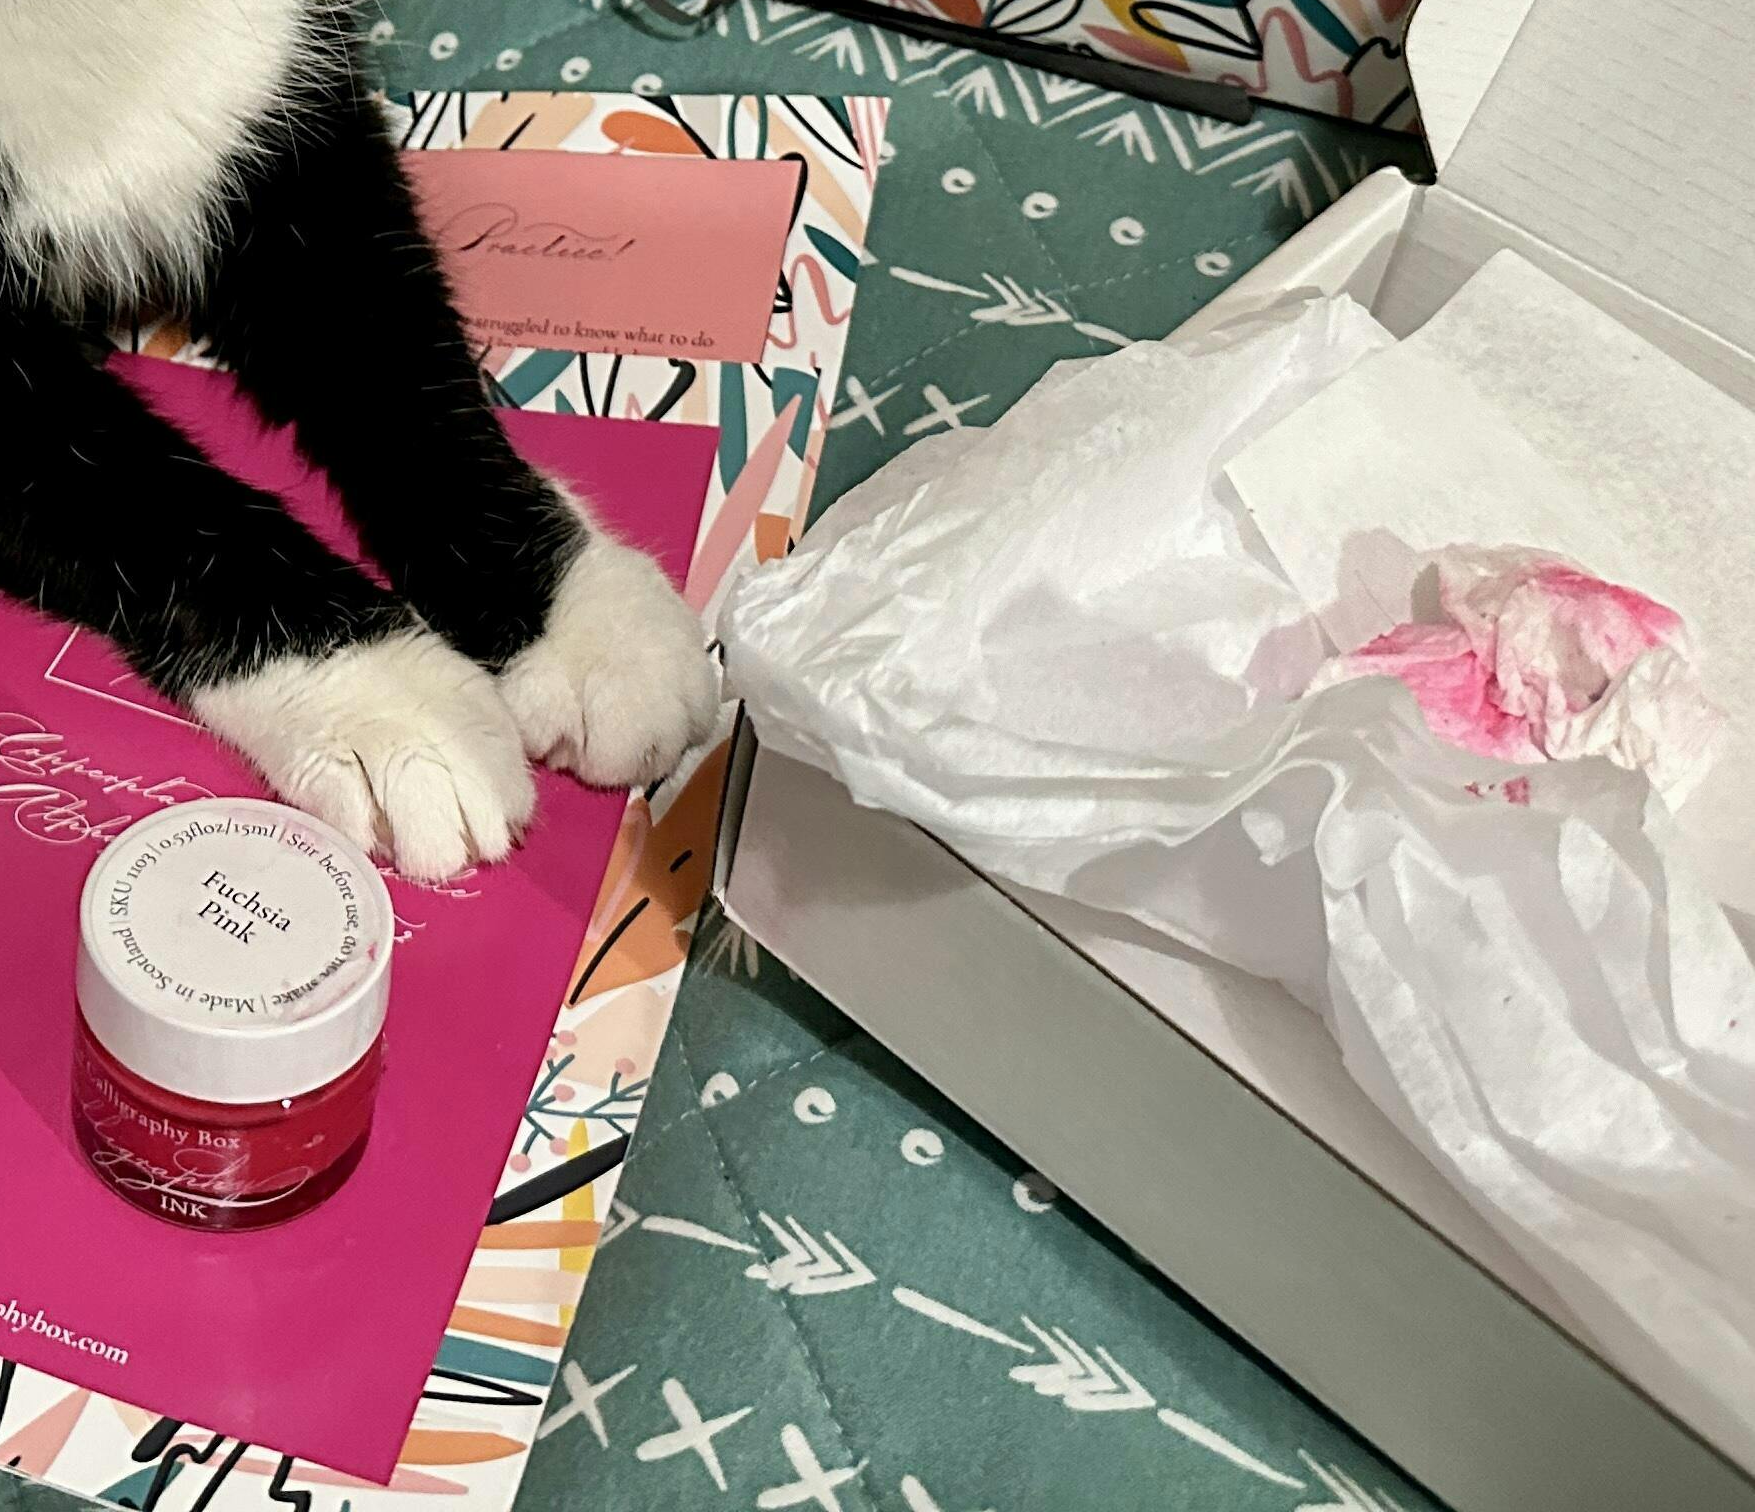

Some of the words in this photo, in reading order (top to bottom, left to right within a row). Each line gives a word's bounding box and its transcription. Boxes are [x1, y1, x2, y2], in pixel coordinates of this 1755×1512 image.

[437, 201, 636, 262] Practice!
[474, 316, 549, 337] struggled
[553, 321, 571, 336] to
[574, 320, 620, 339] know
[624, 324, 665, 345] what
[669, 331, 688, 347] to
[691, 330, 715, 348] do
[286, 832, 320, 859] Stir
[125, 851, 159, 880] 1103
[318, 853, 356, 901] before
[109, 879, 133, 917] SKU
[200, 869, 293, 933] Fuchsia
[196, 899, 258, 946] Pink
[112, 925, 174, 991] Scotland
[340, 935, 357, 956] do
[173, 982, 195, 1003] in
[198, 991, 256, 1014] Made
[196, 1128, 242, 1150] Box
[159, 1193, 210, 1220] INK
